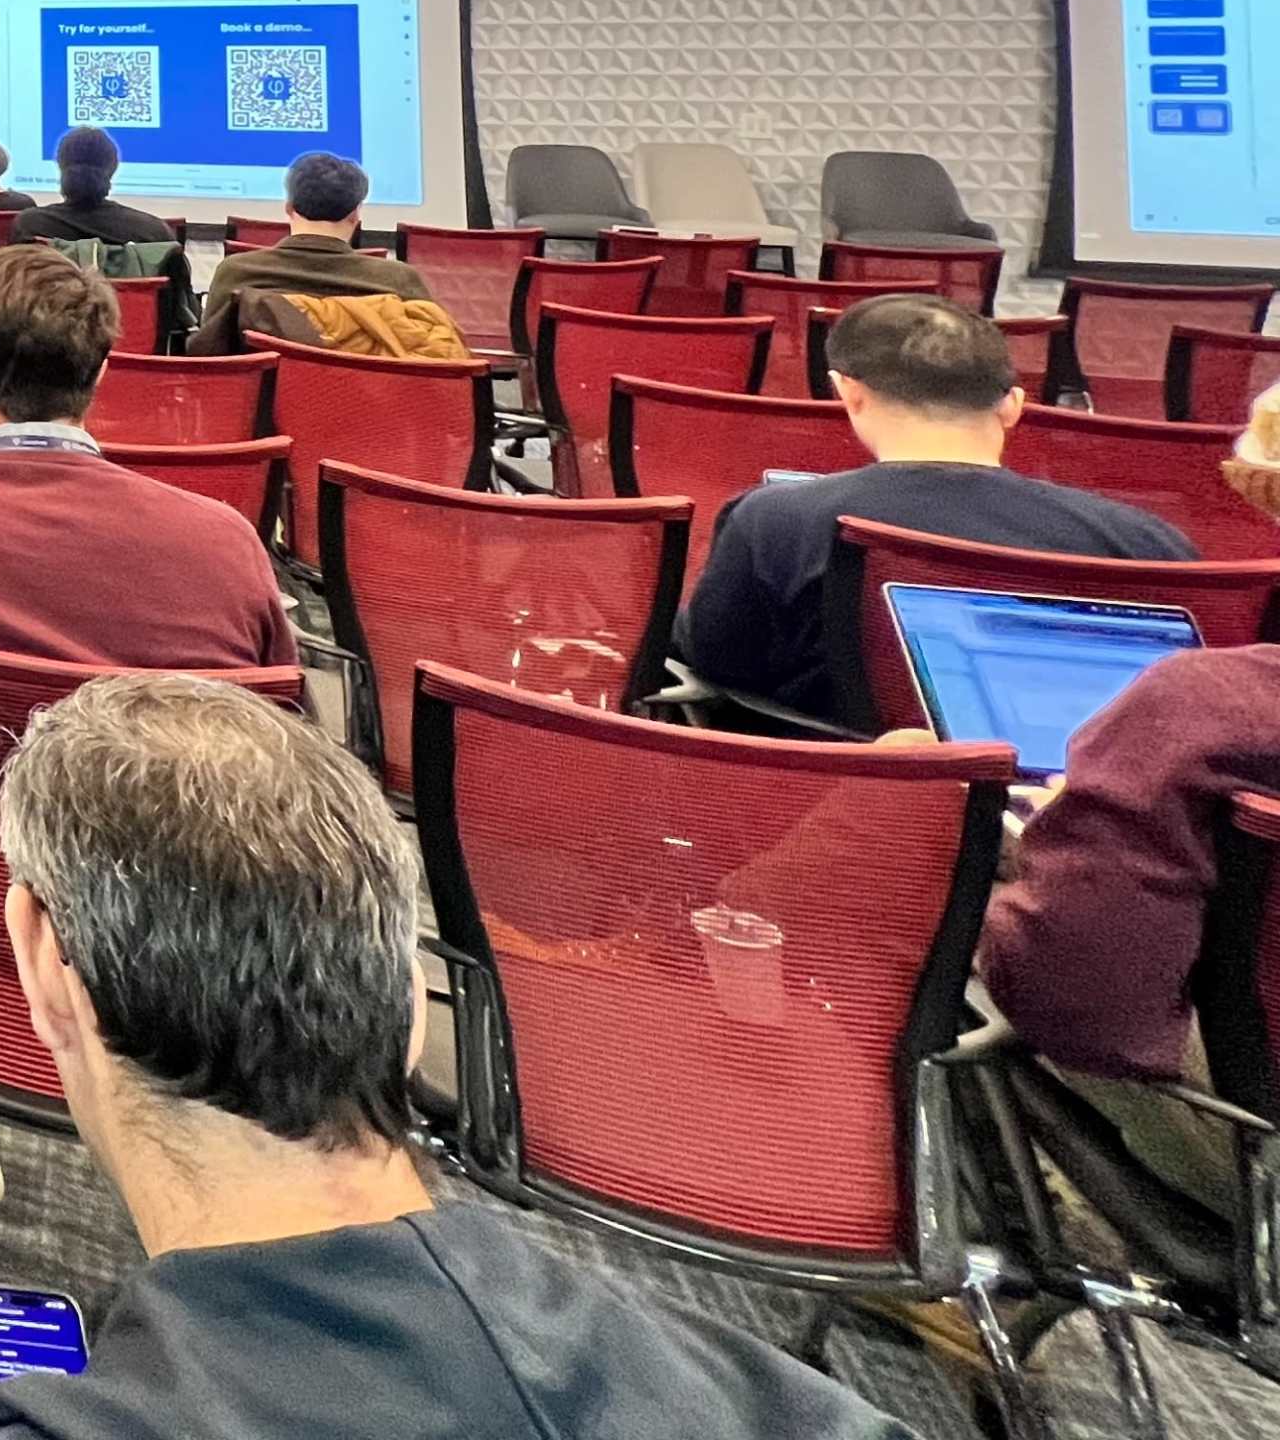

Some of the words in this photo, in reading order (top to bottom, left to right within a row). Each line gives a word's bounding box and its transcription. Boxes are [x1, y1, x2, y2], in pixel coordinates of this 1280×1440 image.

[58, 24, 77, 36] Try
[79, 23, 96, 33] for
[220, 23, 252, 33] Book
[254, 24, 263, 32] a
